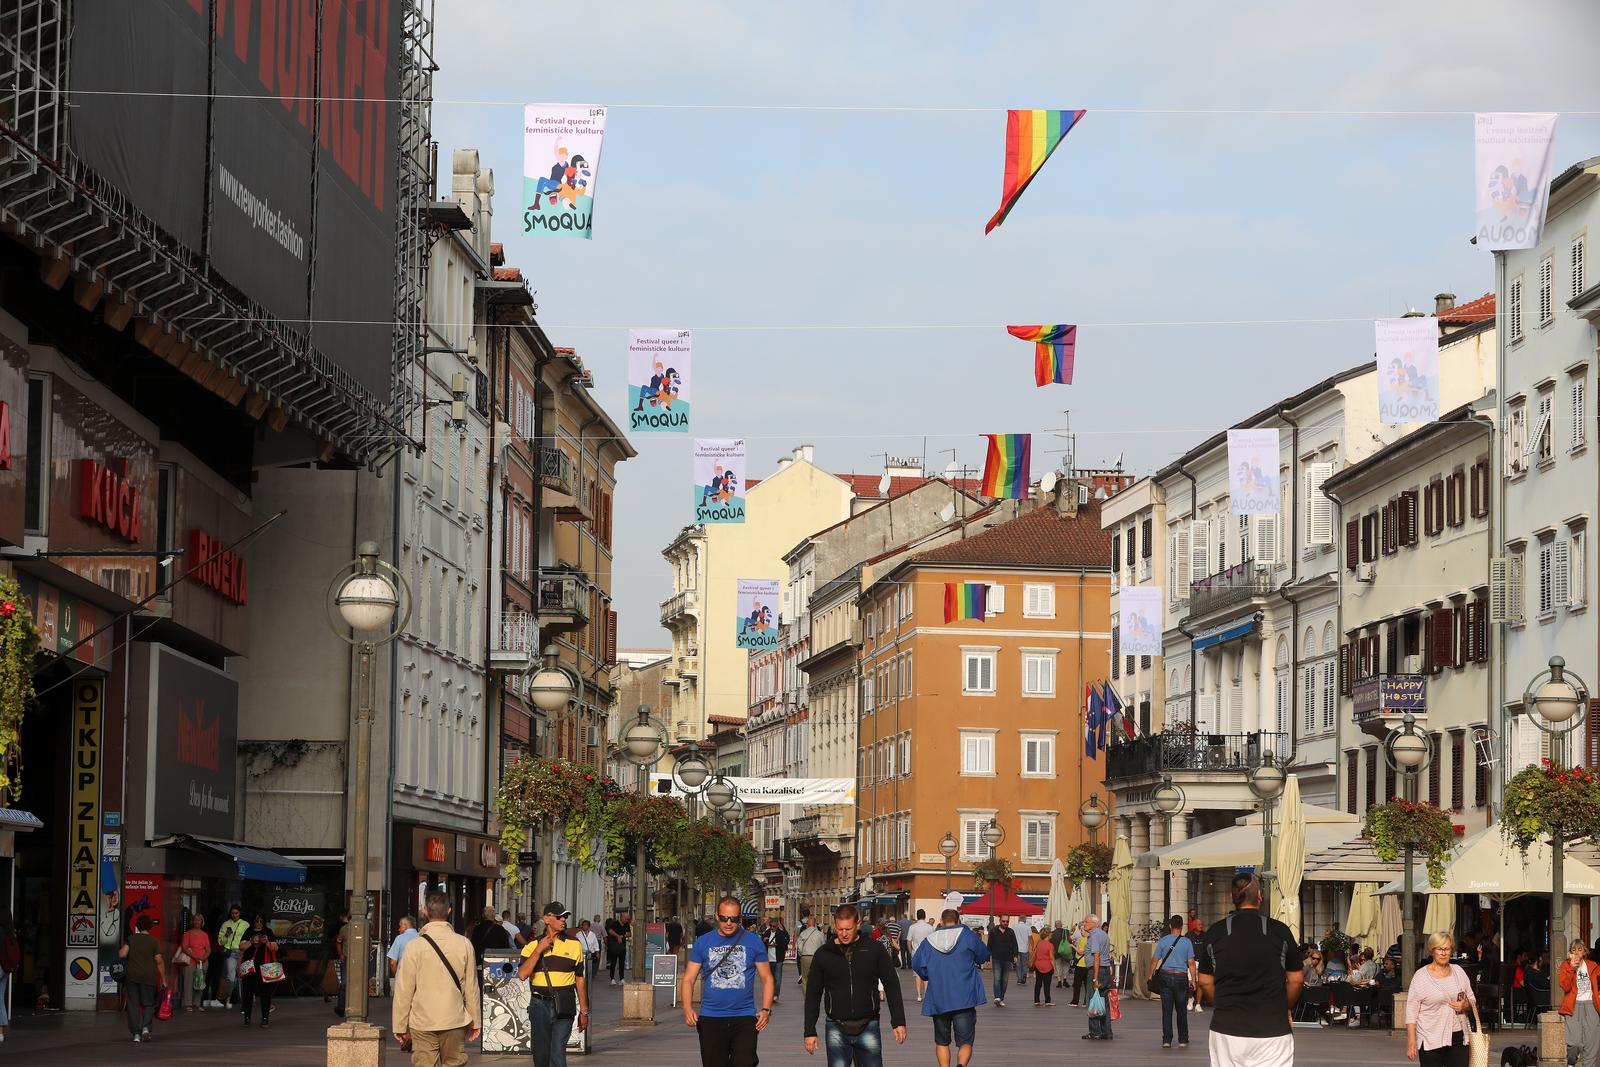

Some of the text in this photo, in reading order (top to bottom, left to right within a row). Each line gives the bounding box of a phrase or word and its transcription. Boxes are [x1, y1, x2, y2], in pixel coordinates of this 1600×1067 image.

[535, 117, 566, 125] Festival
[525, 126, 605, 135] feminističke kulture
[220, 163, 303, 261] www.newyorker.fashion
[524, 211, 592, 233] SMOQUA
[631, 412, 689, 429] SMOQUA
[696, 507, 745, 521] SMOQUA
[193, 528, 248, 607] RIJEKA
[737, 635, 777, 647] SMOQUA
[1387, 681, 1423, 690] HAPPY
[72, 685, 98, 908] OTKUP ZLATA
[762, 786, 805, 795] Kazalište!
[70, 935, 95, 943] ULAZ
